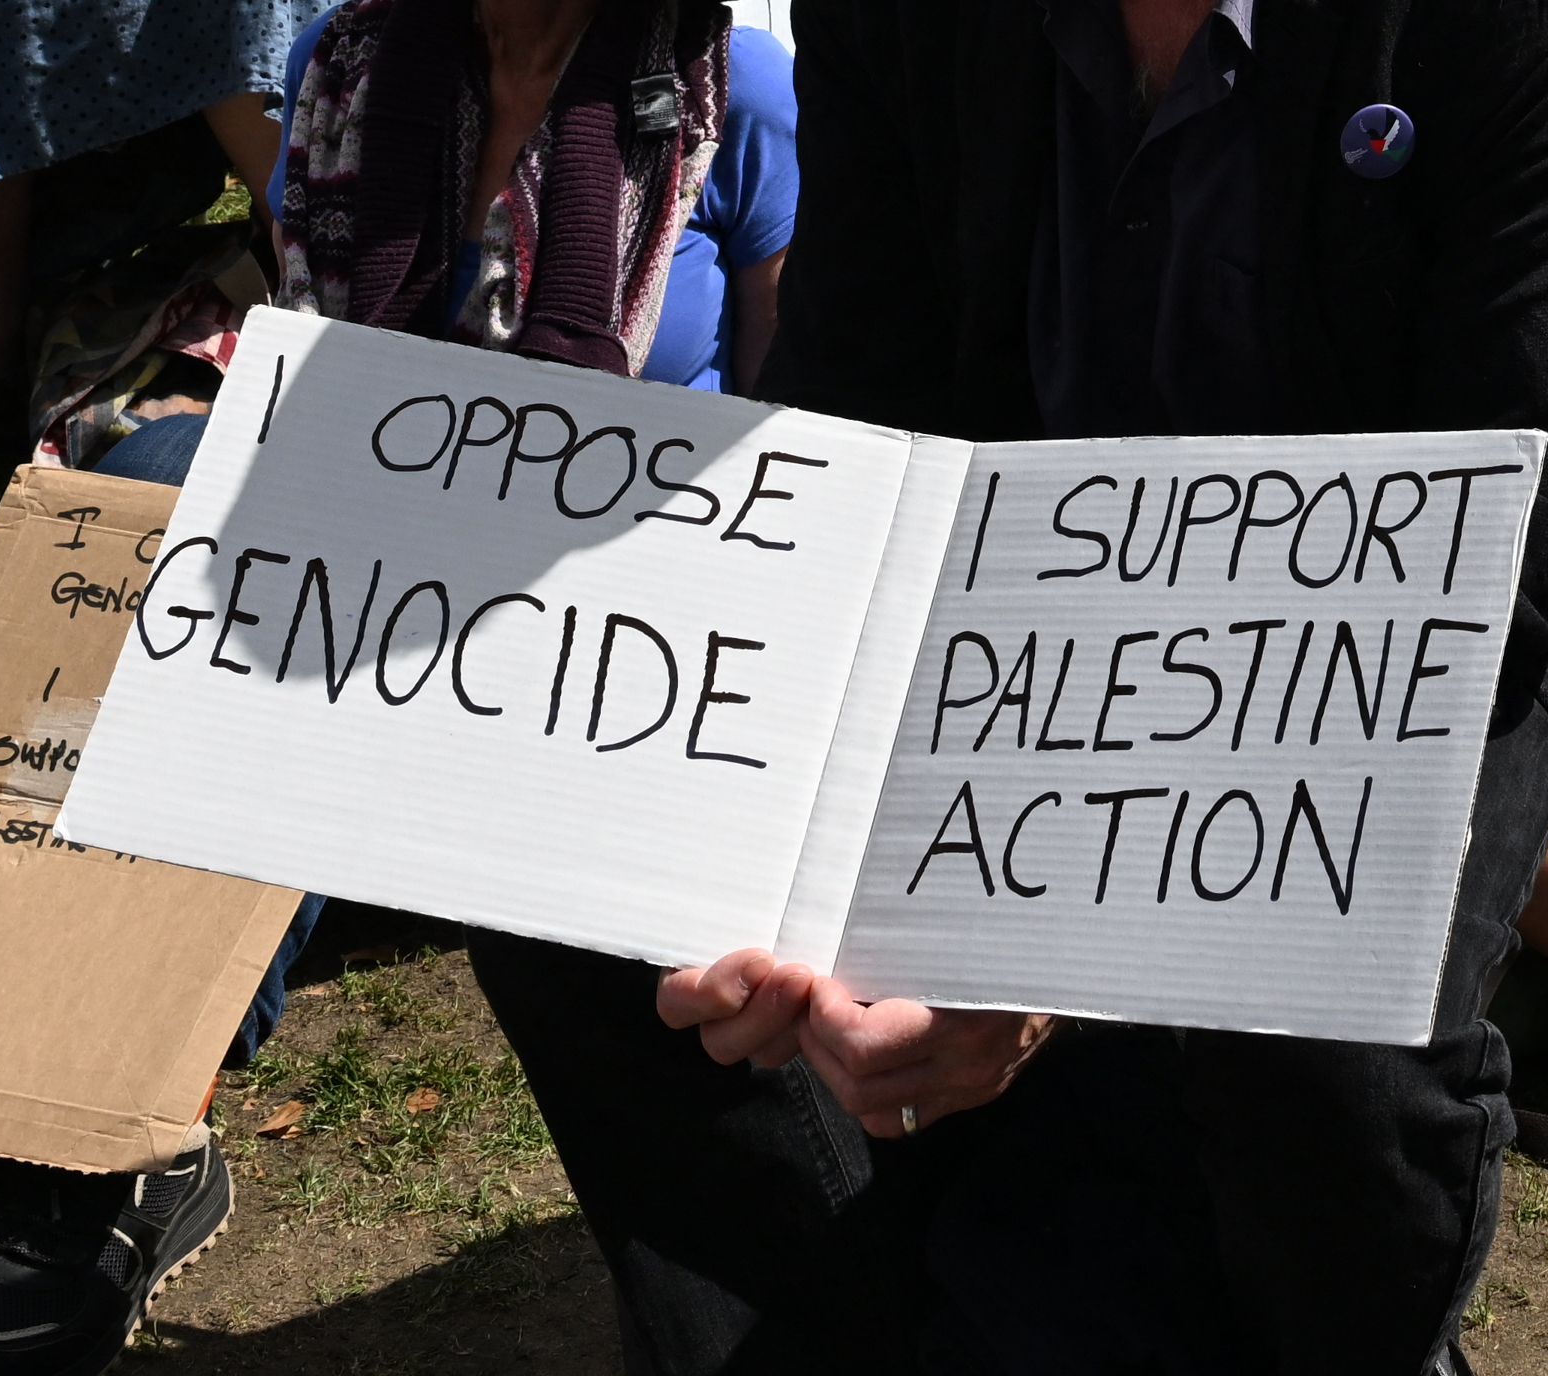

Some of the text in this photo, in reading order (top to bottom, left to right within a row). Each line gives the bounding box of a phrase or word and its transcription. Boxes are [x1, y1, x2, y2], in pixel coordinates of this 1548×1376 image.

[258, 355, 829, 551] I OPPOSE
[966, 465, 1523, 595] I SUPPORT
[137, 537, 766, 769] GENOCIDE
[931, 618, 1489, 754] PALESTINE
[907, 776, 1372, 915] ACTION
